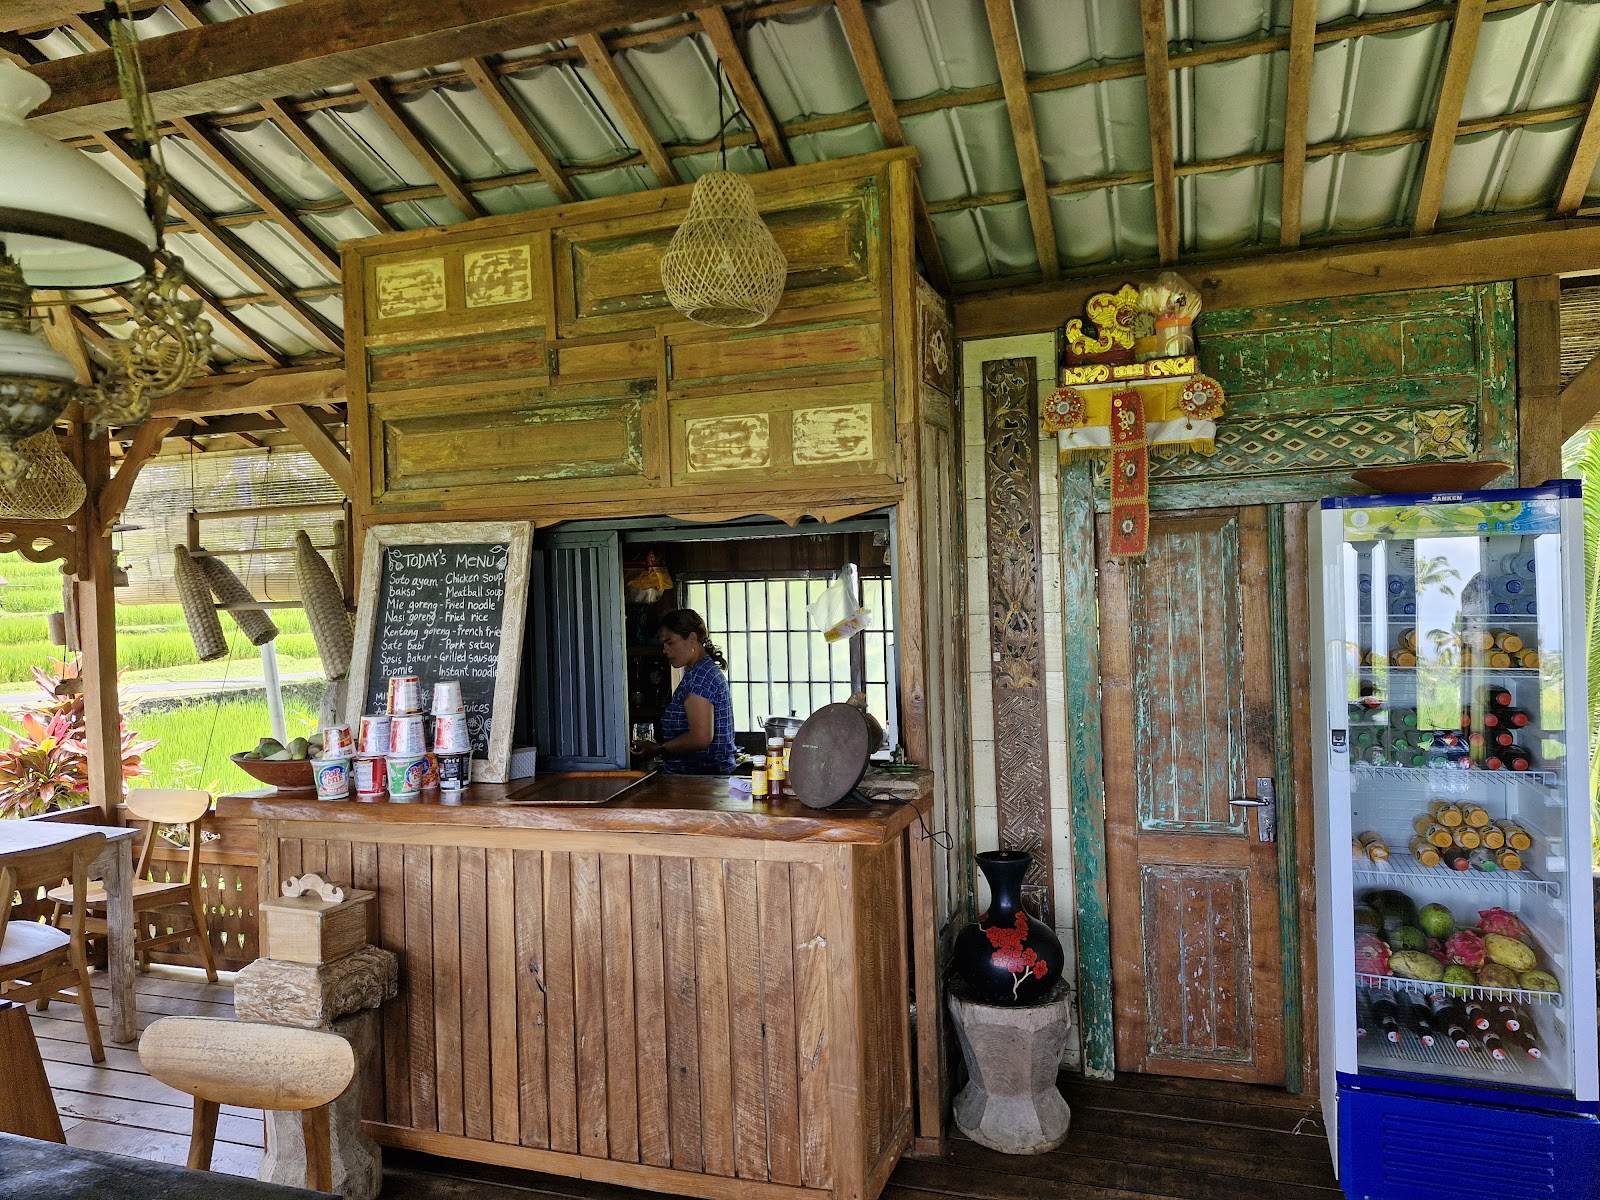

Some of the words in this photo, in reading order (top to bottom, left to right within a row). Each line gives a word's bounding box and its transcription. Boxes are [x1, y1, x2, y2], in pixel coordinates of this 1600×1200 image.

[390, 572, 410, 585] Soto
[411, 577, 438, 590] ayam
[445, 571, 479, 585] Chicken
[389, 585, 416, 597] Bakso
[445, 586, 483, 598] Meatball
[484, 589, 504, 602] soup
[386, 597, 404, 610] Mie
[407, 600, 438, 614] goreng
[445, 598, 465, 610] Fried
[467, 598, 496, 610] noodle
[384, 610, 405, 623] Nasi
[406, 613, 436, 627] goreng
[445, 611, 465, 622] Fried
[471, 612, 489, 622] rice
[383, 625, 419, 641] Kentang
[420, 628, 450, 640] goreng
[457, 624, 484, 637] French
[381, 638, 402, 651] Sate
[407, 639, 425, 651] Babi
[445, 639, 465, 651] Pork
[468, 642, 495, 654] satay
[380, 651, 402, 665] Sosis
[406, 652, 432, 663] Bakar
[439, 650, 466, 662] Grilled
[382, 664, 413, 677] Popmie
[439, 664, 469, 677] Instant
